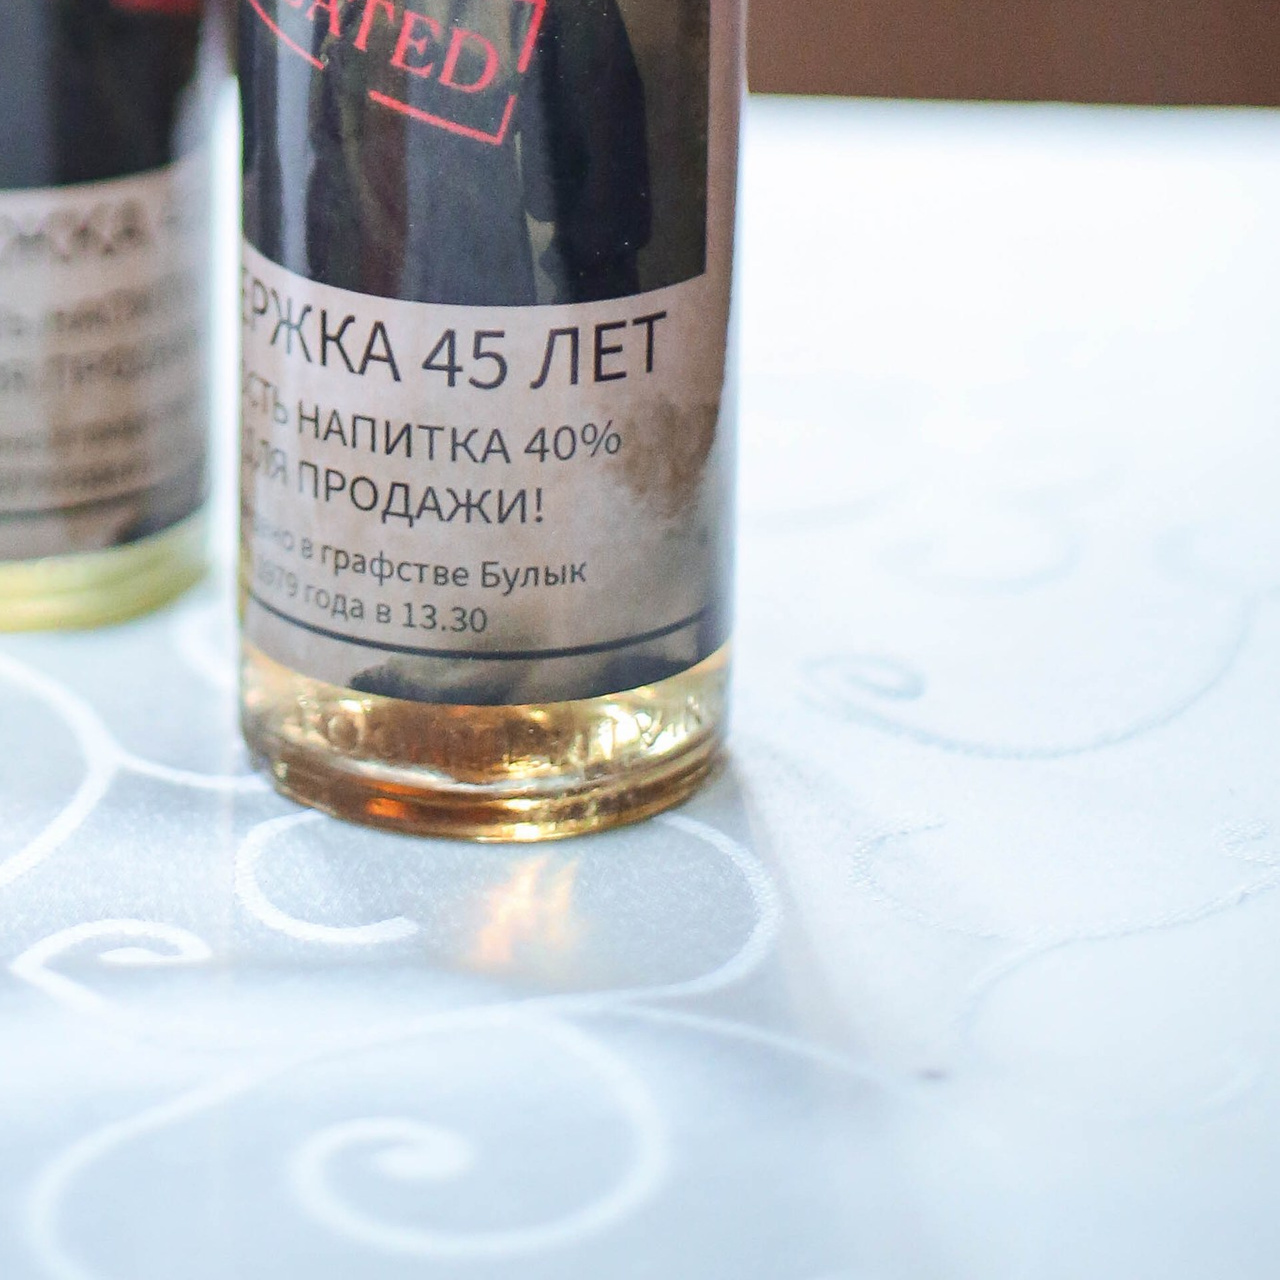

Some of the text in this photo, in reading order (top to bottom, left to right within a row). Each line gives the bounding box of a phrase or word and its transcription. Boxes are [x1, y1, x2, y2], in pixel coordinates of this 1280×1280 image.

[242, 267, 401, 382] РЖКА
[421, 328, 508, 391] 45
[530, 310, 668, 391] ЛЕТ
[297, 398, 511, 465] НАПИТКА
[524, 419, 622, 463] 40%
[297, 460, 545, 528] ПРОДАЖИ!
[300, 536, 314, 560] в
[320, 543, 470, 587] графстве
[480, 561, 587, 596] Булык
[304, 582, 365, 622] года
[375, 603, 392, 625] в
[401, 602, 488, 634] 13.30
